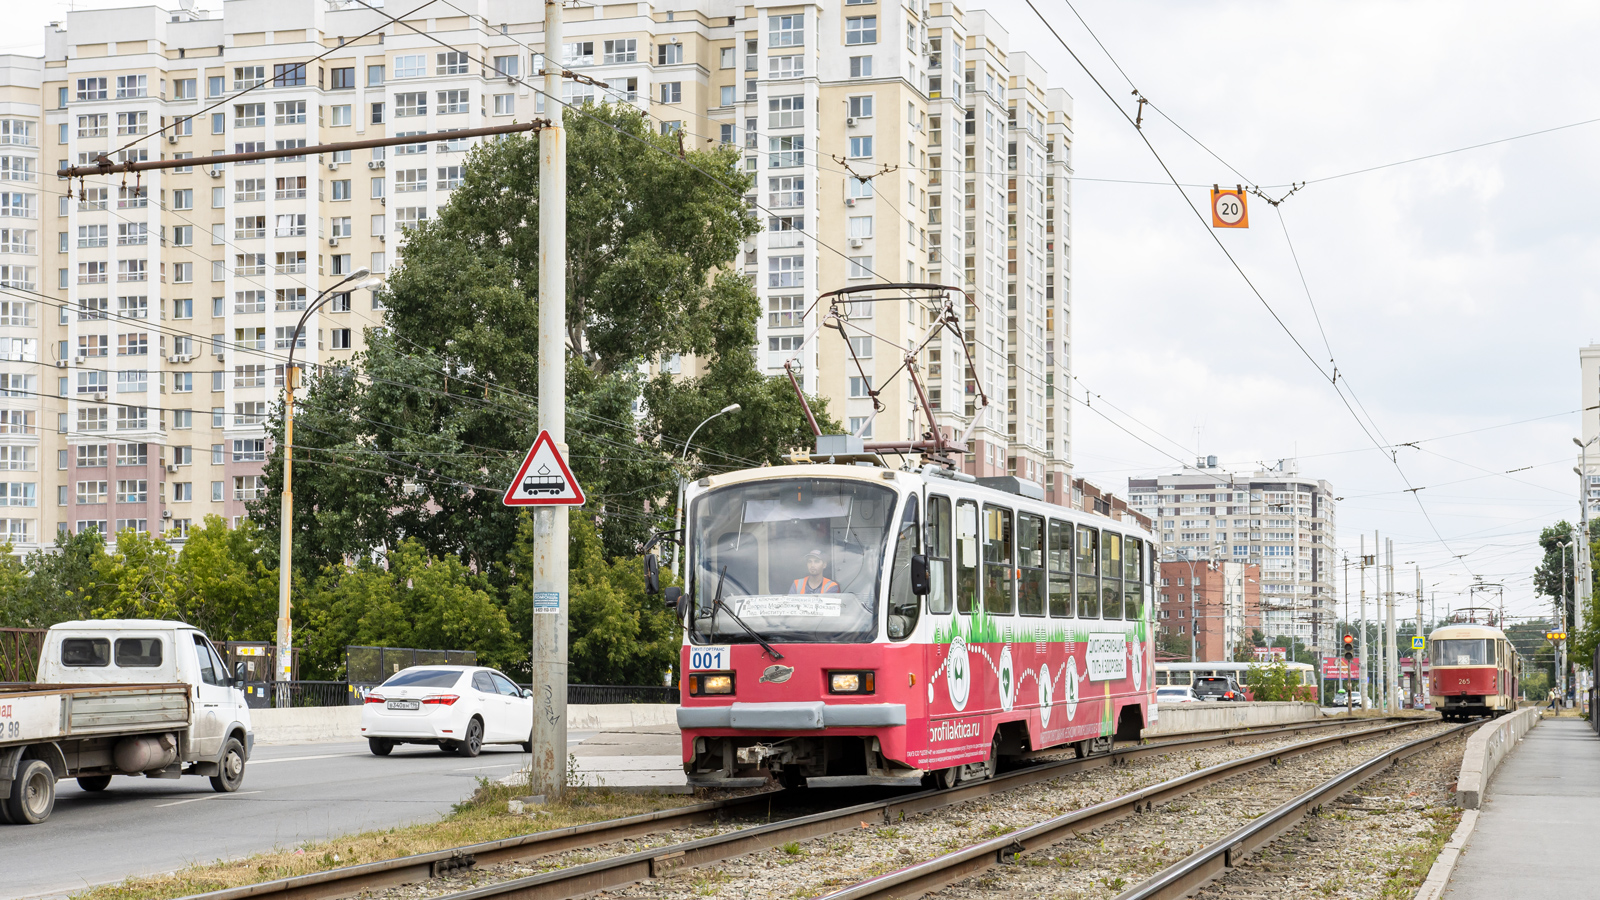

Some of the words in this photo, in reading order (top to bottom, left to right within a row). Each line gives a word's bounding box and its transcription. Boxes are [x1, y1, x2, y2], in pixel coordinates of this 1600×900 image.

[1221, 202, 1239, 216] 20
[692, 652, 721, 669] 001
[0, 704, 12, 718] ад
[8, 720, 20, 739] 98
